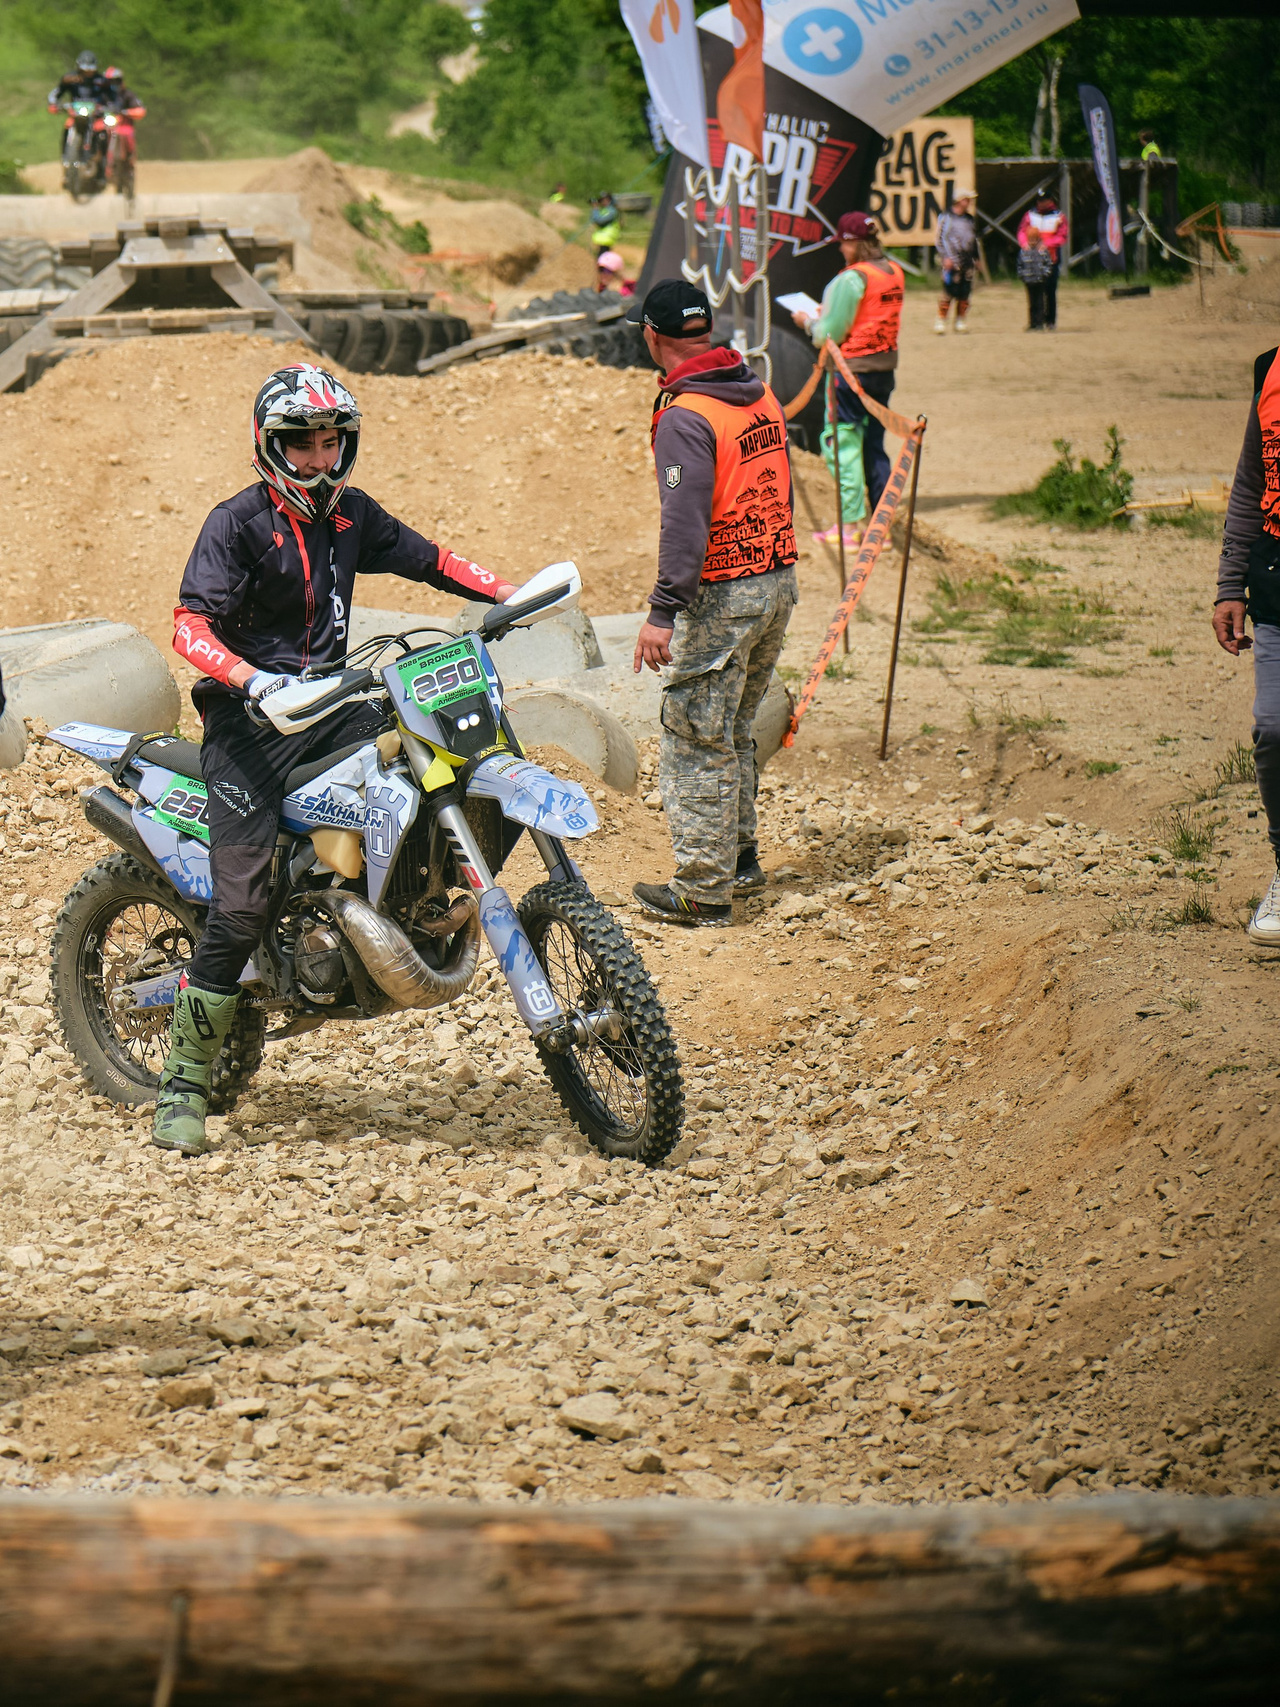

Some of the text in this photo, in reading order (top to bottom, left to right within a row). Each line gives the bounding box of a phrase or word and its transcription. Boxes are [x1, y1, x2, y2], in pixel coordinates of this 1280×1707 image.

[885, 3, 1049, 106] www.maremed.ru
[870, 179, 955, 234] RUN
[739, 425, 782, 460] МАРШАЛ
[412, 656, 482, 704] 250
[437, 687, 478, 706] Александр
[167, 819, 203, 837] Александр
[299, 795, 383, 829] SAKHALIN
[305, 812, 353, 828] ENDURO
